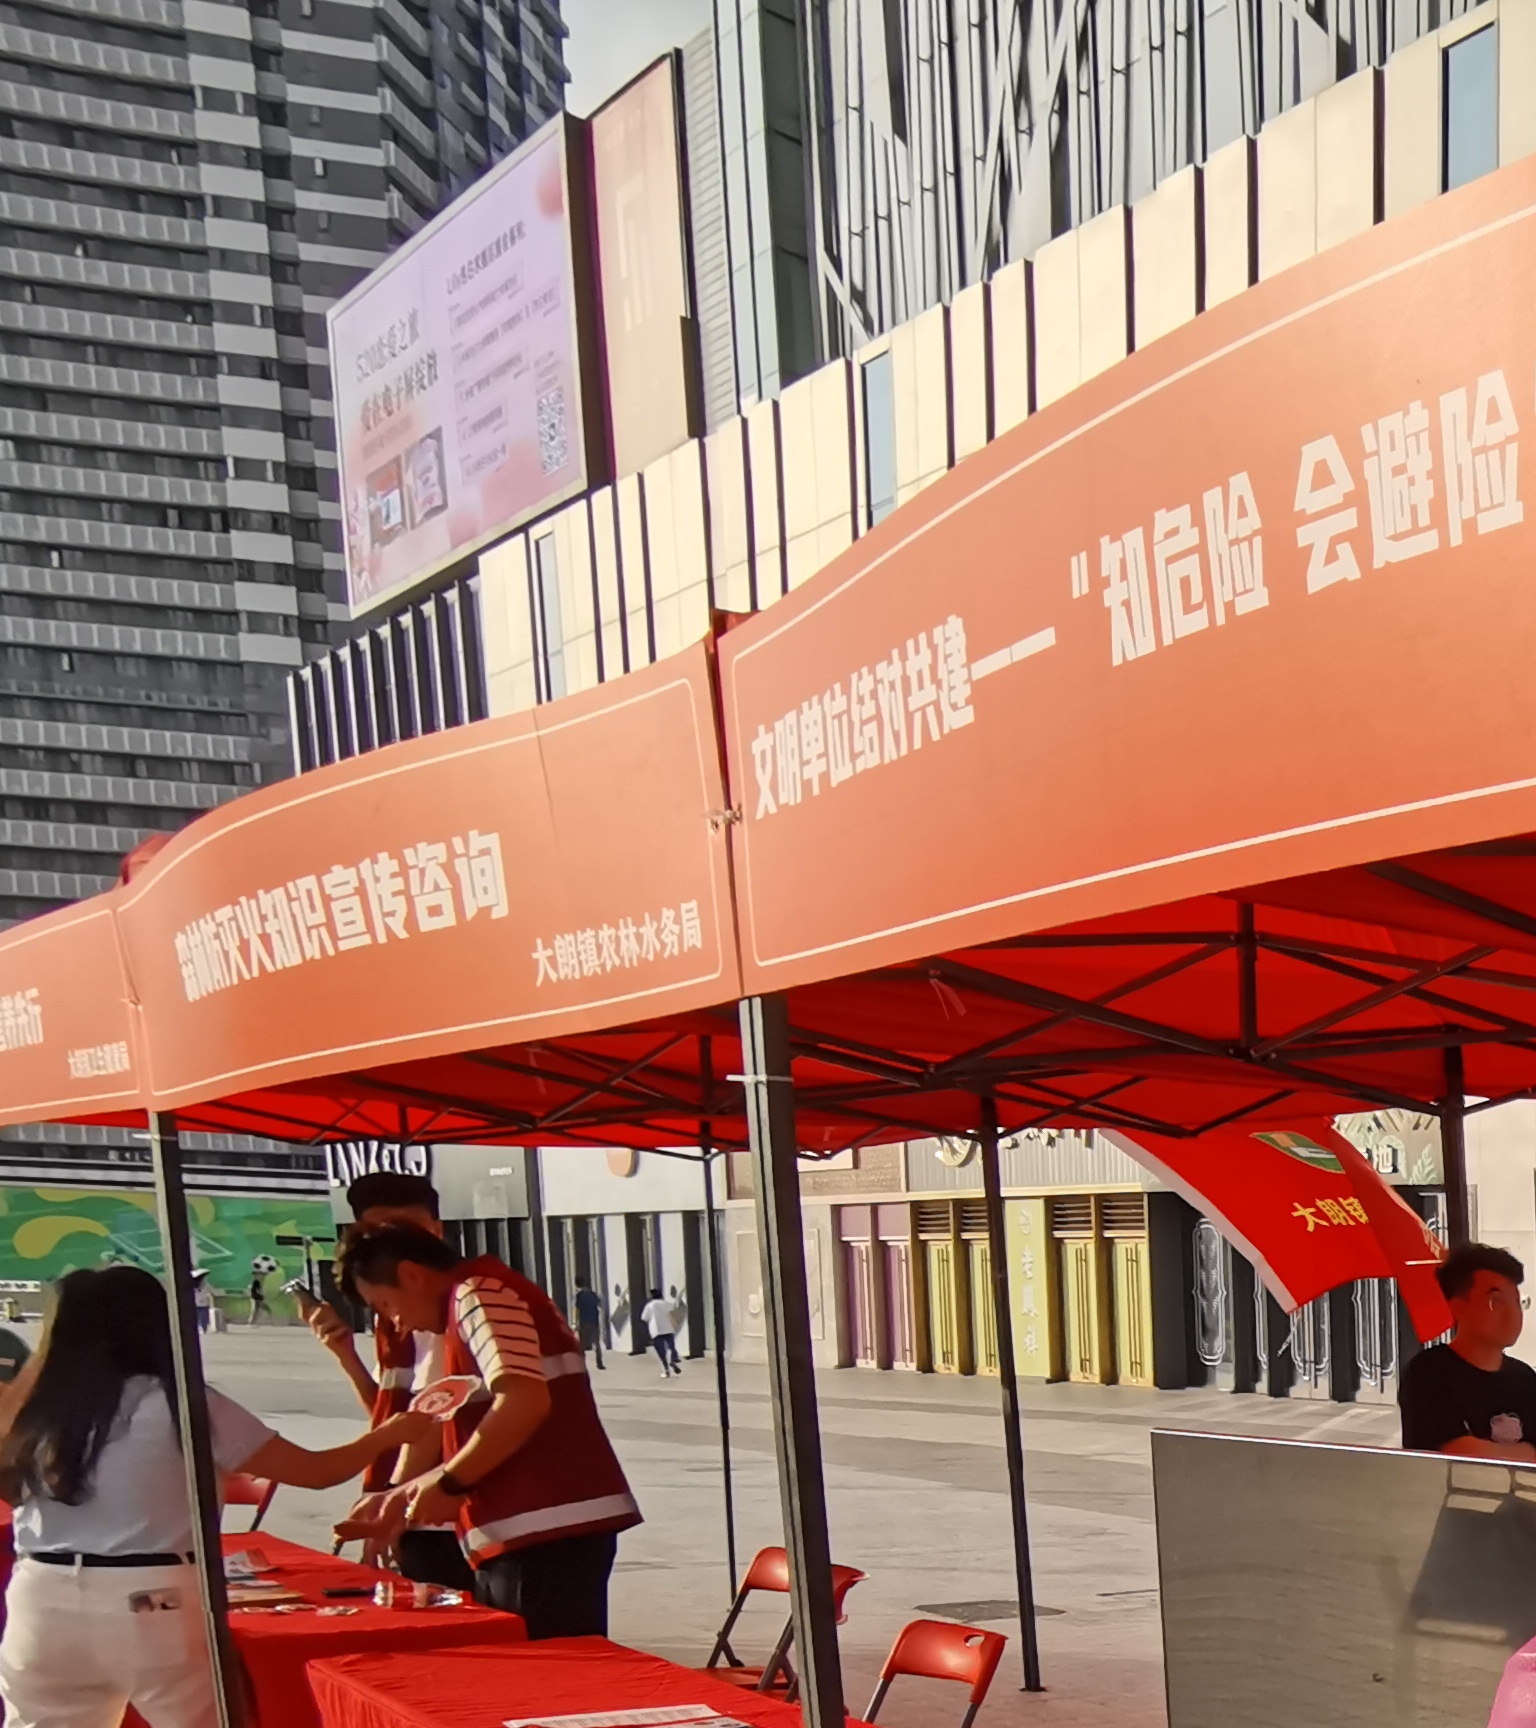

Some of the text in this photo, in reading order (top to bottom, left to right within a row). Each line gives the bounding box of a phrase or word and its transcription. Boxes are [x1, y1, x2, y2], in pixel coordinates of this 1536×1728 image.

[531, 899, 703, 988] 大朗镇农林水务局
